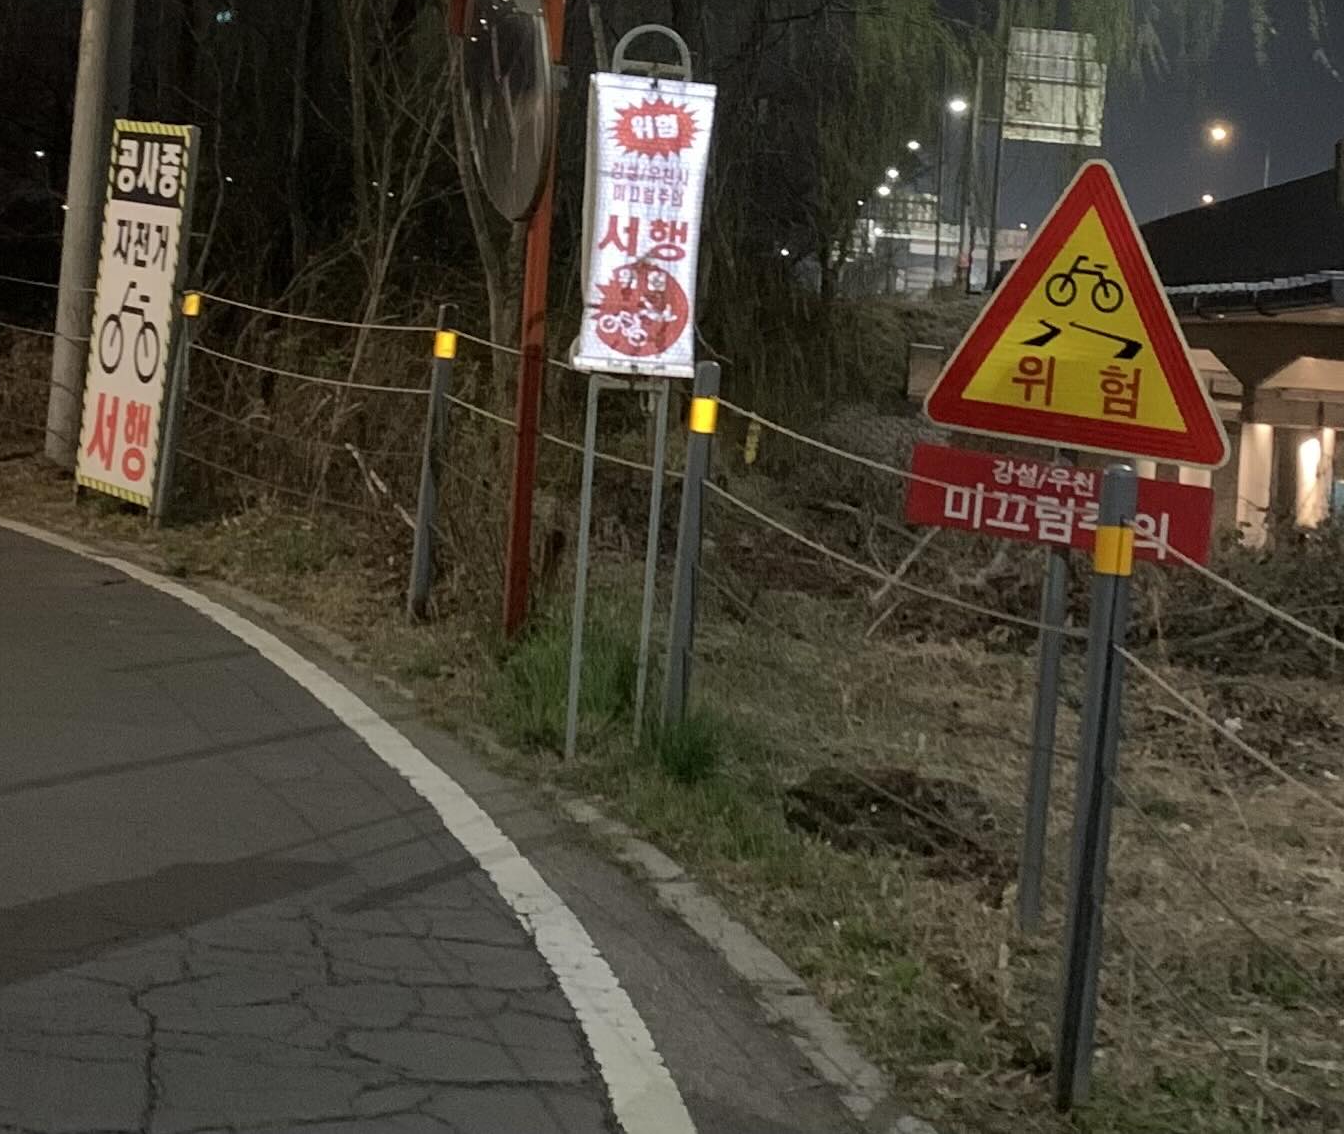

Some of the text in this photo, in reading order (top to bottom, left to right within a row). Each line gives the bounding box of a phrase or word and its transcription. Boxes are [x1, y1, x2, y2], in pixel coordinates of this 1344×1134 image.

[630, 113, 679, 140] 위험
[116, 138, 183, 199] 공사중
[113, 218, 170, 272] 자전거
[598, 215, 689, 262] 서행
[86, 392, 153, 482] 서행
[992, 459, 1096, 497] 강설/우천
